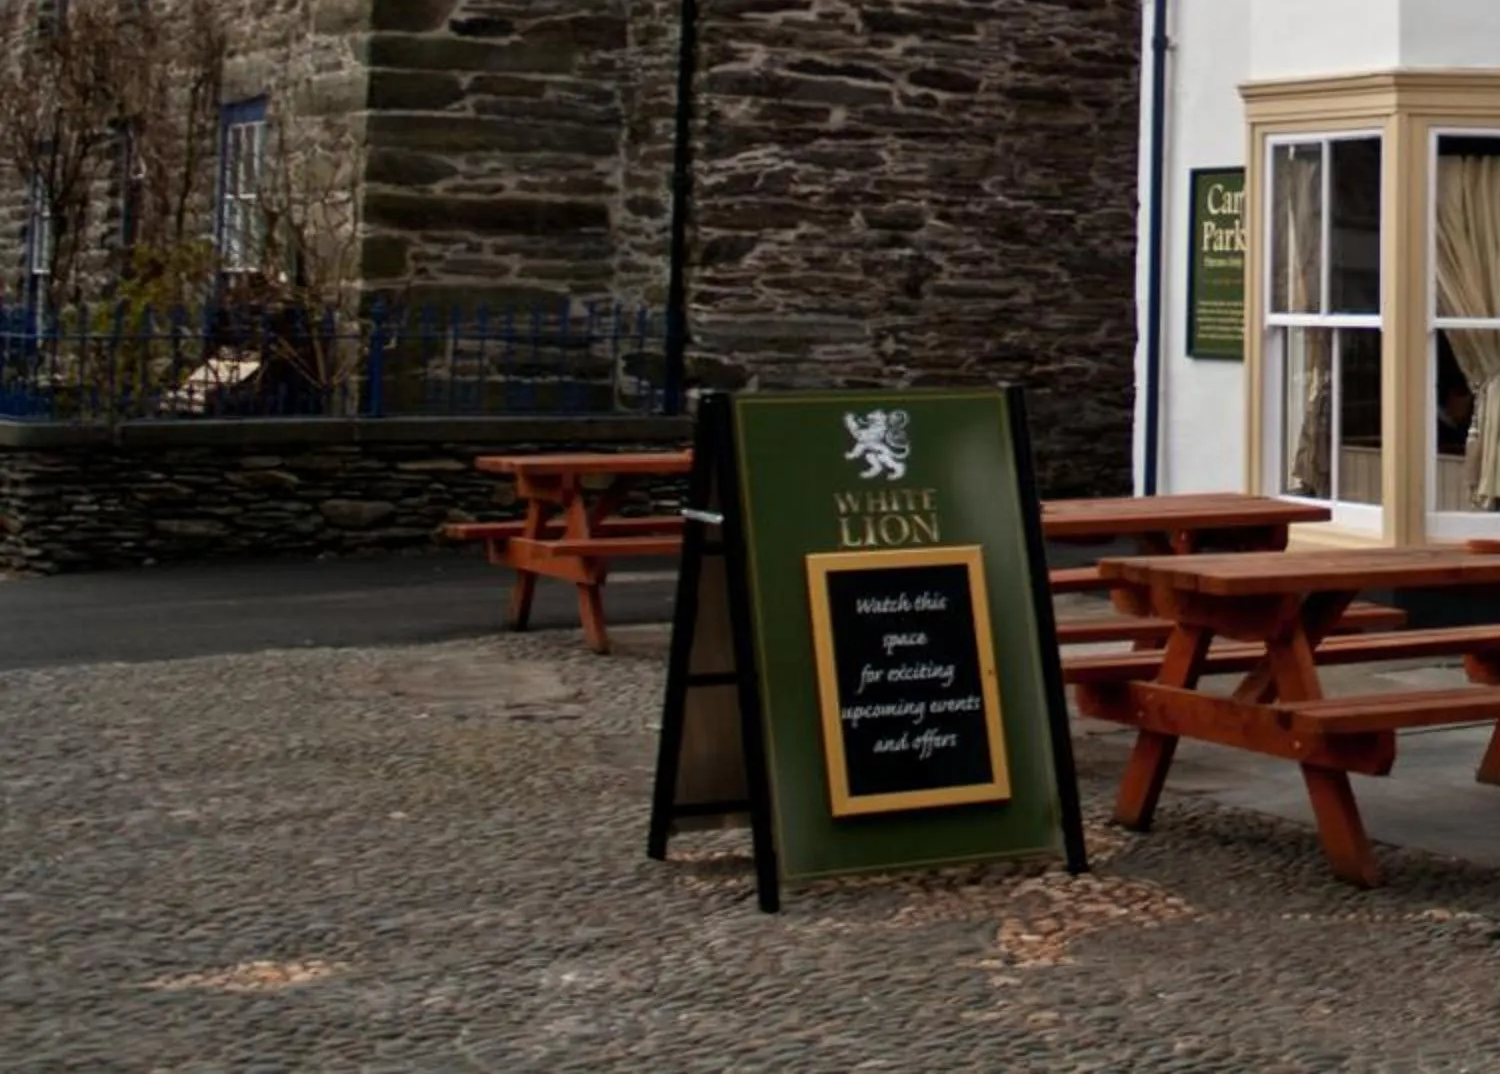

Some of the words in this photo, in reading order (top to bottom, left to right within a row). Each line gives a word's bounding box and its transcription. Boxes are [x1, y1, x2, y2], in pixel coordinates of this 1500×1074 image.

[1202, 220, 1248, 251] Park
[834, 488, 938, 514] WHITE
[839, 514, 941, 546] LION
[856, 592, 911, 614] Watch
[914, 591, 947, 612] this
[883, 631, 928, 654] space
[857, 663, 883, 693] for
[887, 662, 956, 687] exciting
[841, 699, 926, 727] upcoming
[929, 693, 981, 714] events
[873, 732, 910, 754] and
[911, 729, 957, 758] offers
